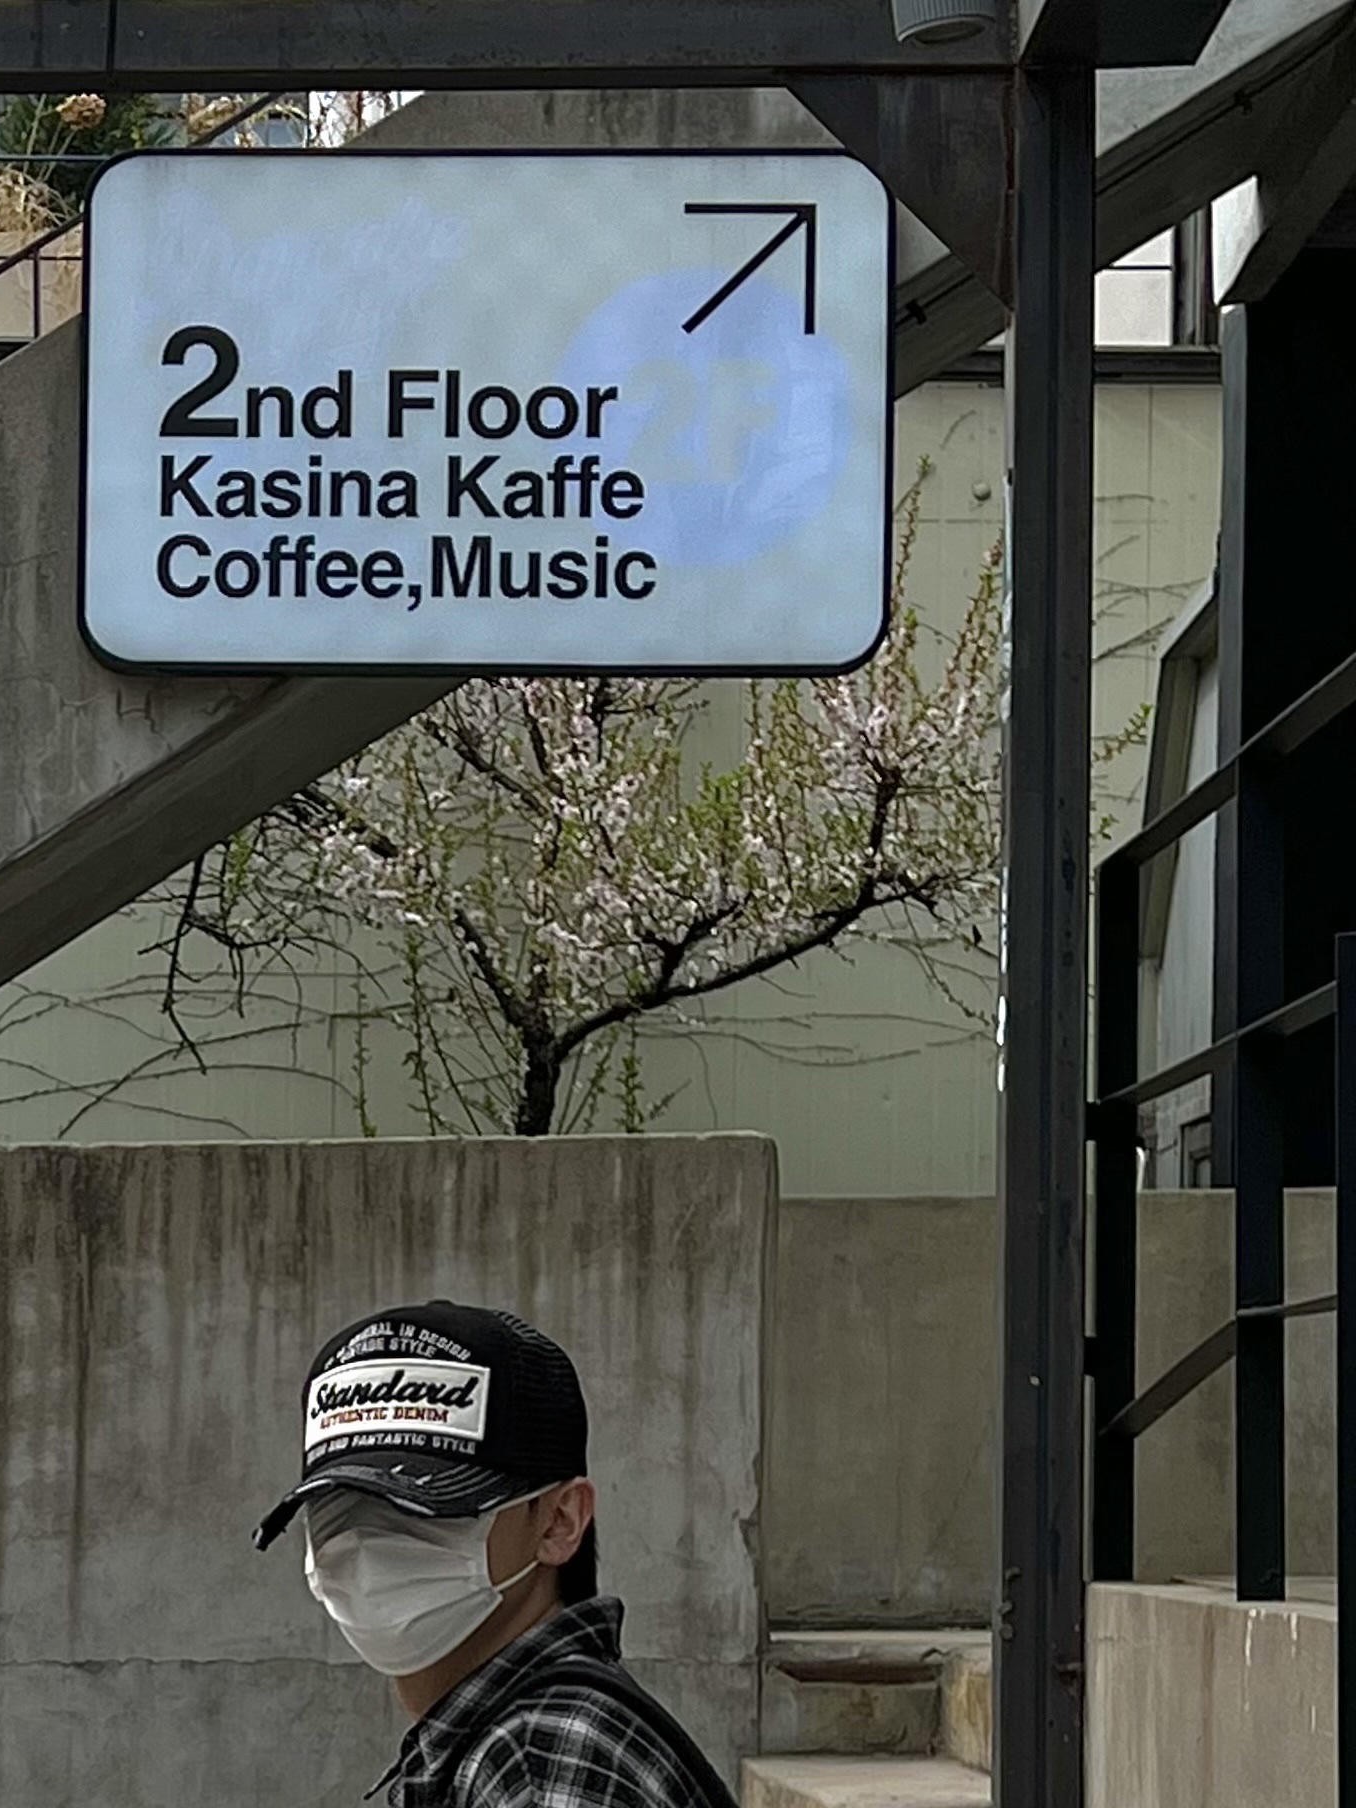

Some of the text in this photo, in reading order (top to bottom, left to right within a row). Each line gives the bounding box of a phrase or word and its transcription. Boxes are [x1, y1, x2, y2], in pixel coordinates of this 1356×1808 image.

[160, 326, 618, 440] 2nd Floor
[160, 455, 645, 519] Kasina Kaffe
[157, 534, 657, 611] Coffee,Music
[389, 1337, 438, 1358] STYLE
[311, 1369, 479, 1419] Standard
[392, 1406, 449, 1423] DENIM
[351, 1432, 426, 1447] FANTASTIC
[432, 1434, 476, 1455] STYLE
